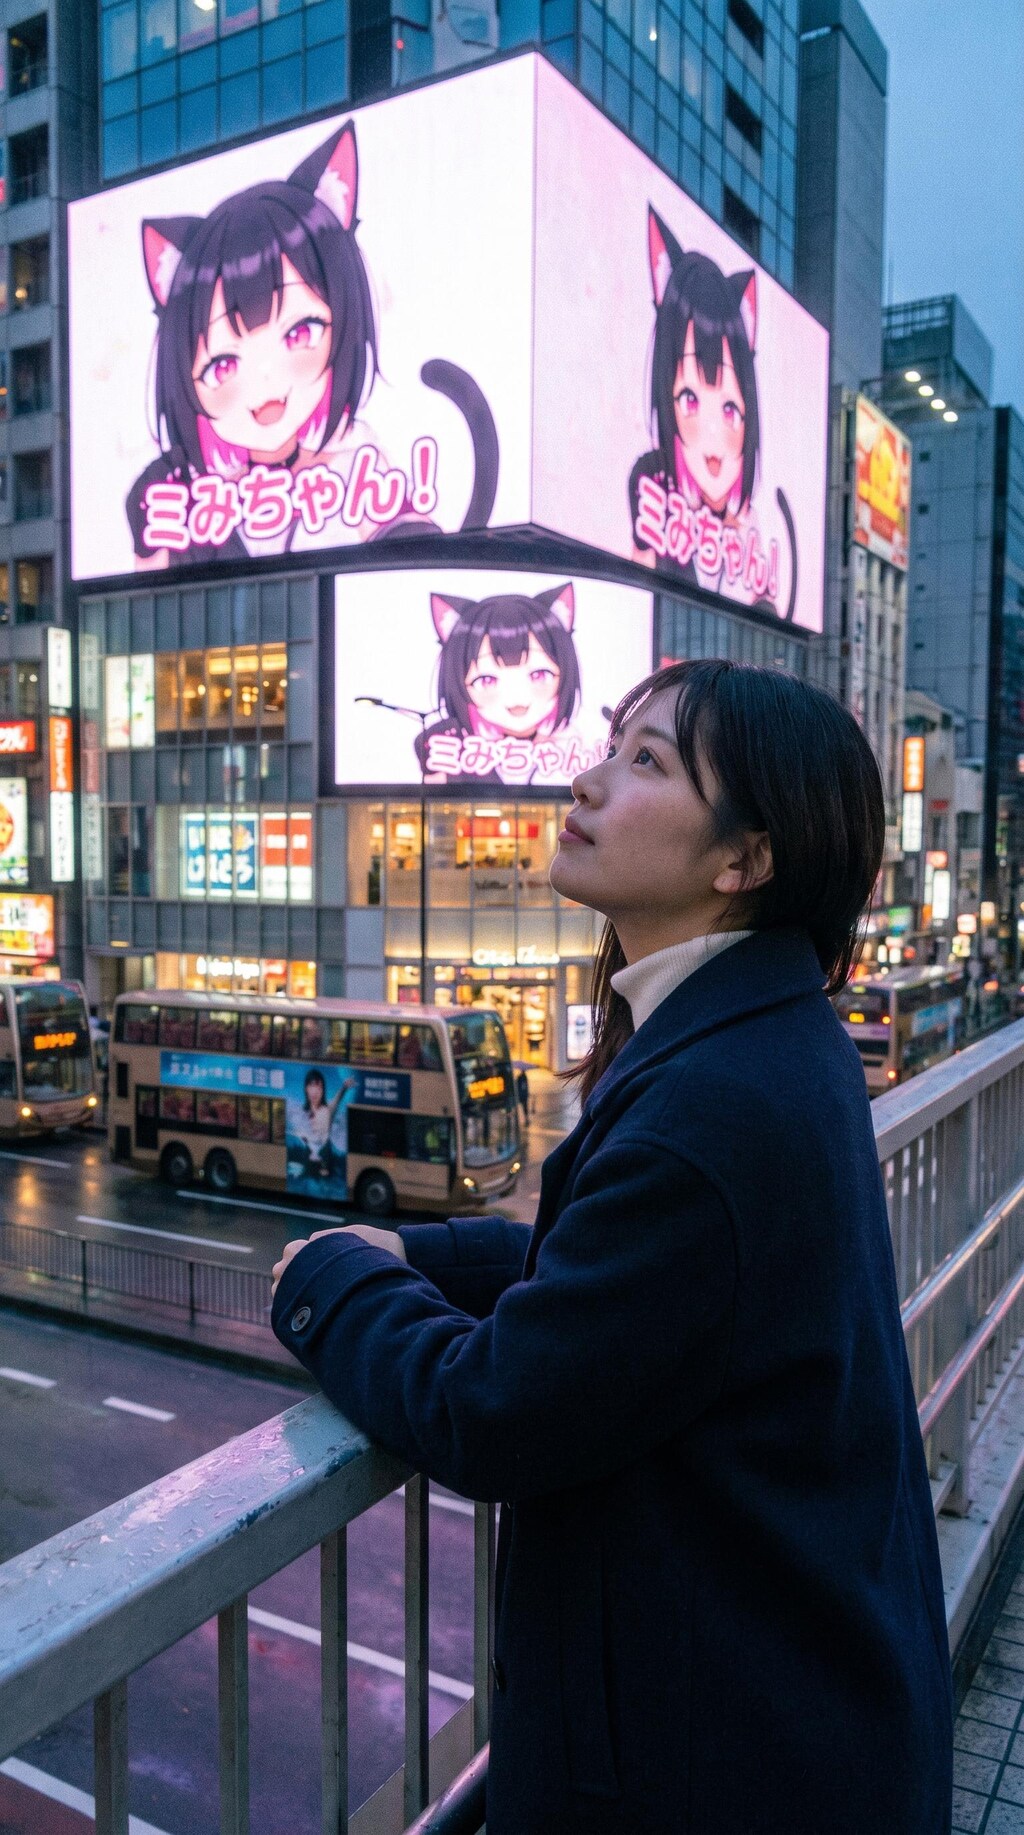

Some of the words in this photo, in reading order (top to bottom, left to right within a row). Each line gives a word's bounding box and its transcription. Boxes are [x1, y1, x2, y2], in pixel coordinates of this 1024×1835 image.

[143, 438, 436, 549] ミみちゃん!
